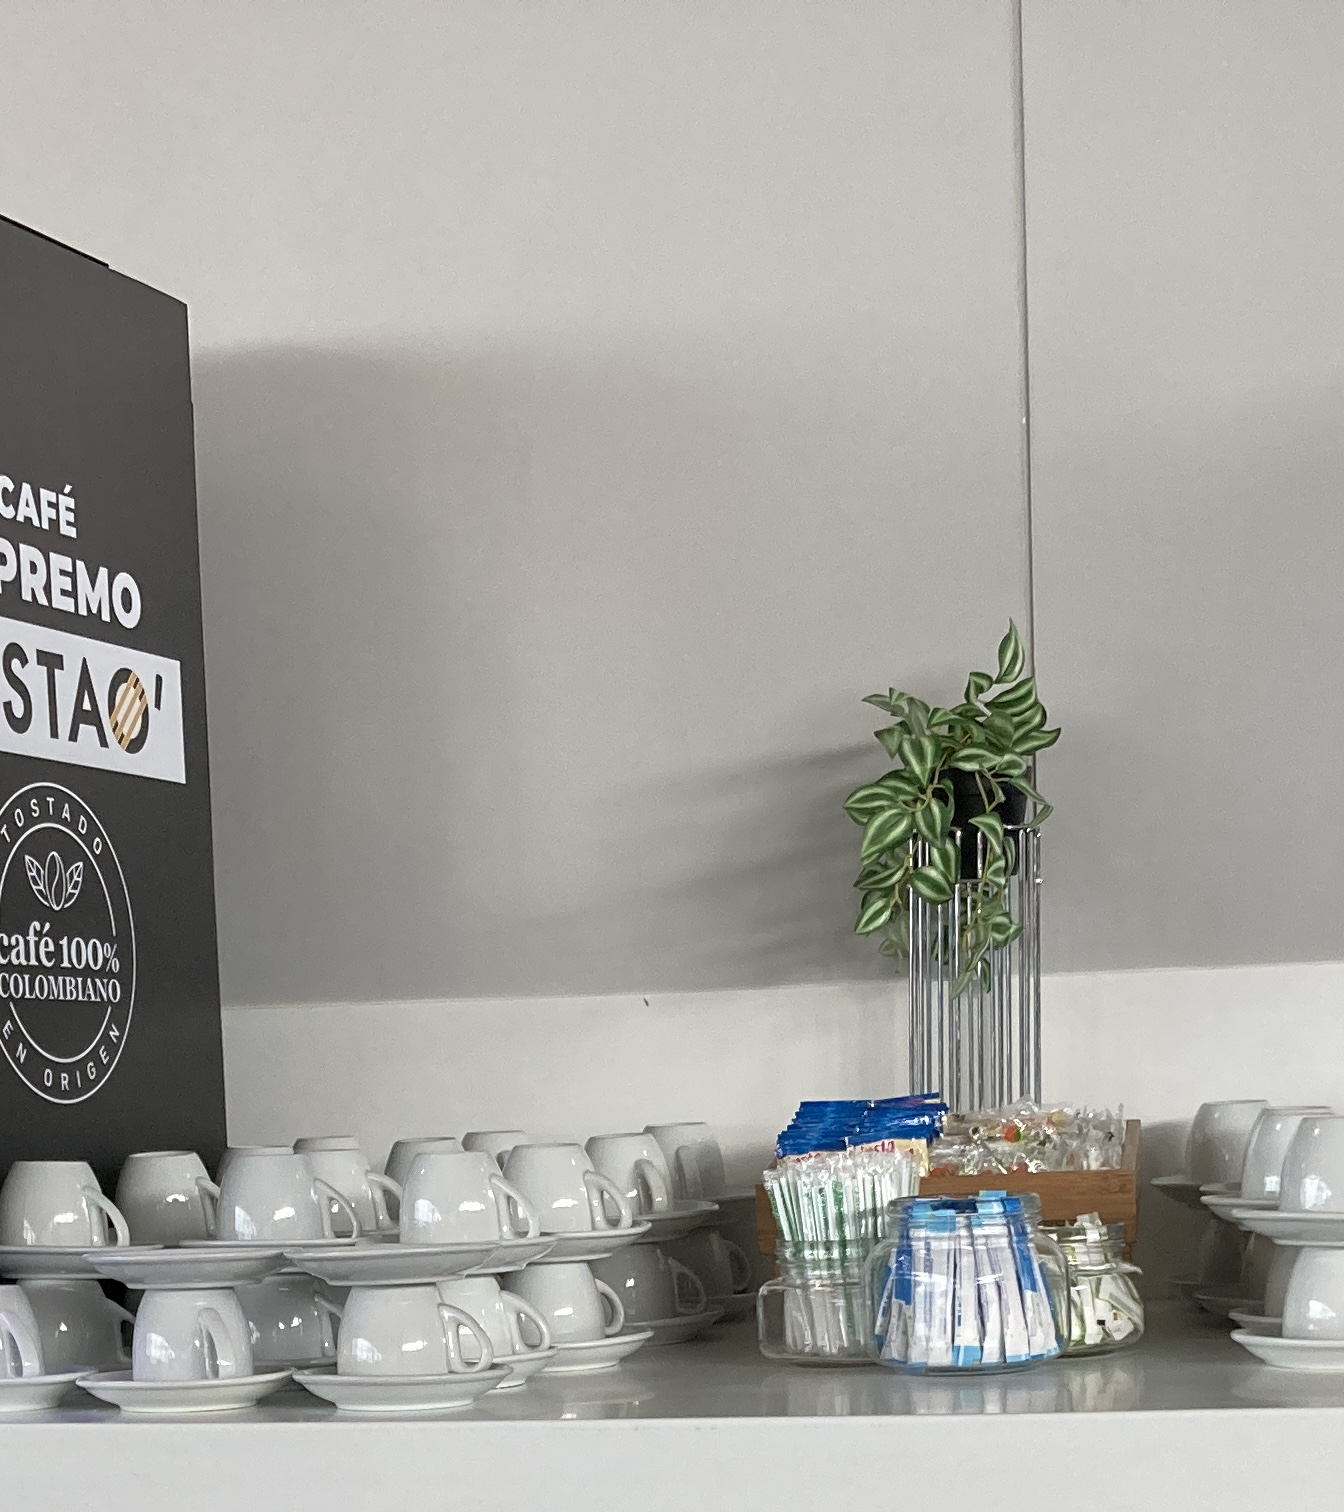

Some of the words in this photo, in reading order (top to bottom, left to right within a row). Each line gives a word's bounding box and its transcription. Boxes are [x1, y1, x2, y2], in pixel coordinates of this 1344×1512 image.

[1, 796, 104, 857] TOSTADO
[58, 936, 121, 974] 100%
[2, 1022, 27, 1064] EN
[43, 1022, 122, 1091] ORIGEN
